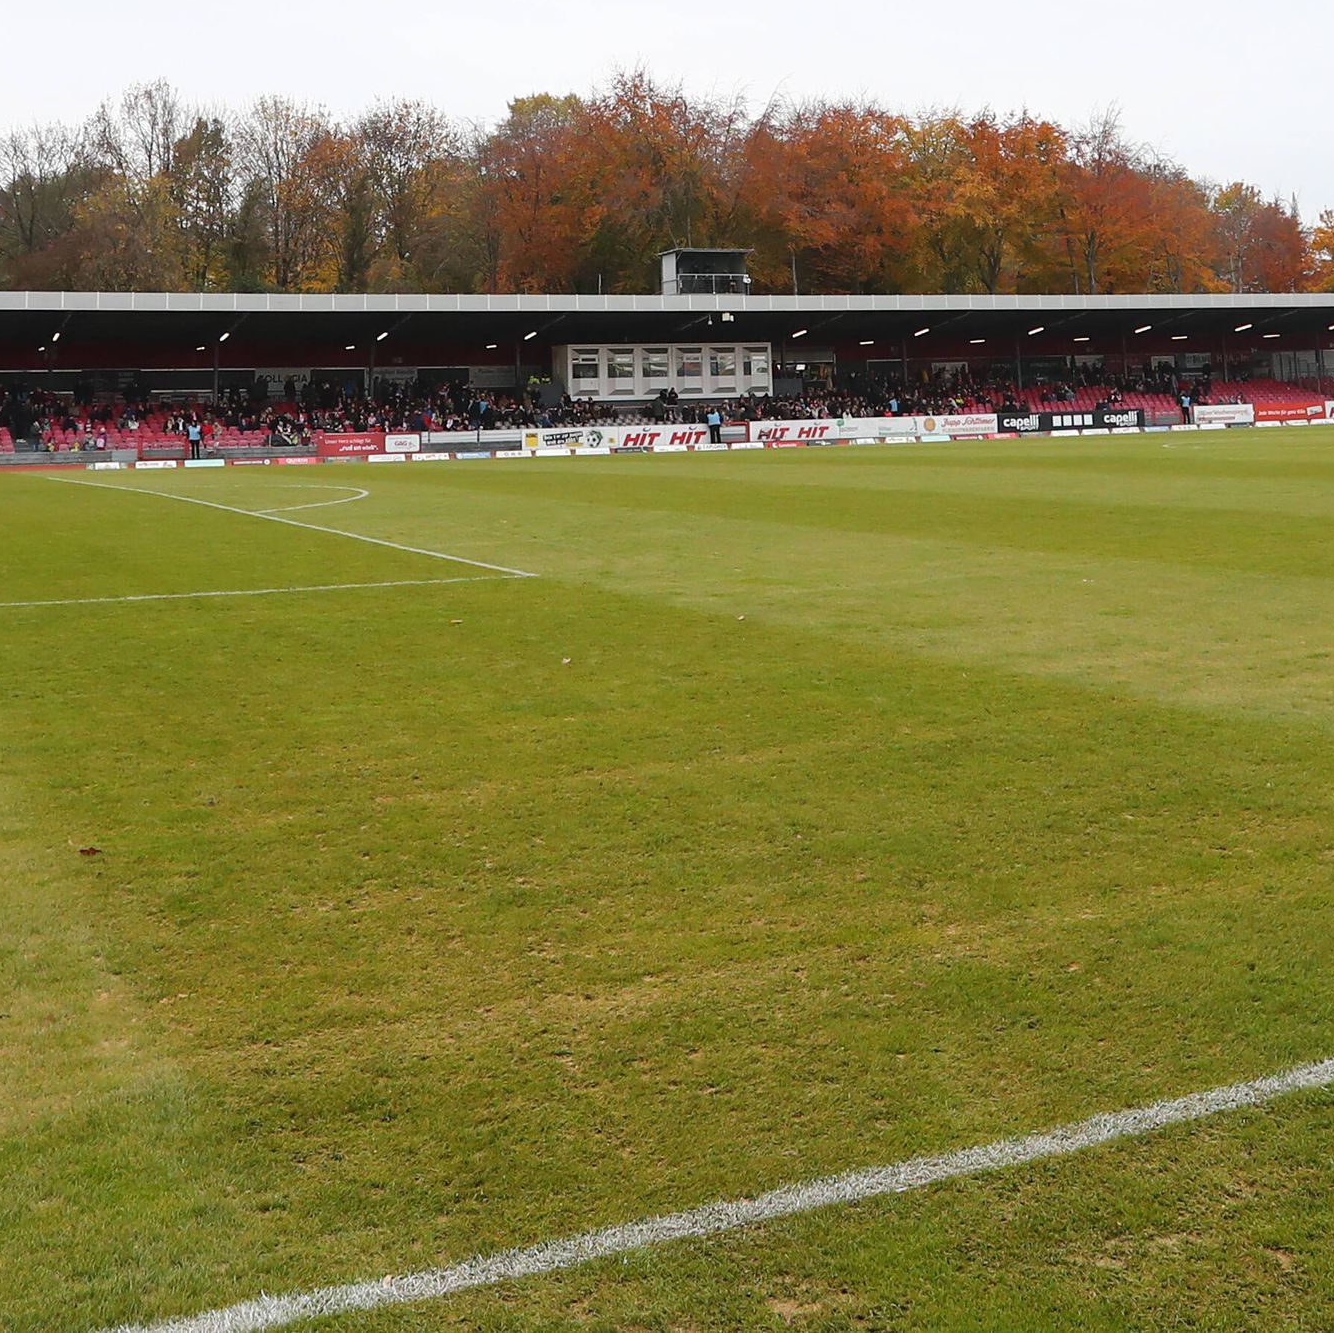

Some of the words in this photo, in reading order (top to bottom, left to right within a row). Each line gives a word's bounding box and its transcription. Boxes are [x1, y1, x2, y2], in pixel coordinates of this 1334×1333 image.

[1003, 414, 1039, 430] capelli
[1103, 410, 1138, 426] capelli
[623, 432, 661, 447] HIT
[669, 430, 707, 445] HIT
[758, 427, 790, 440] HIT
[798, 426, 830, 439] HIT
